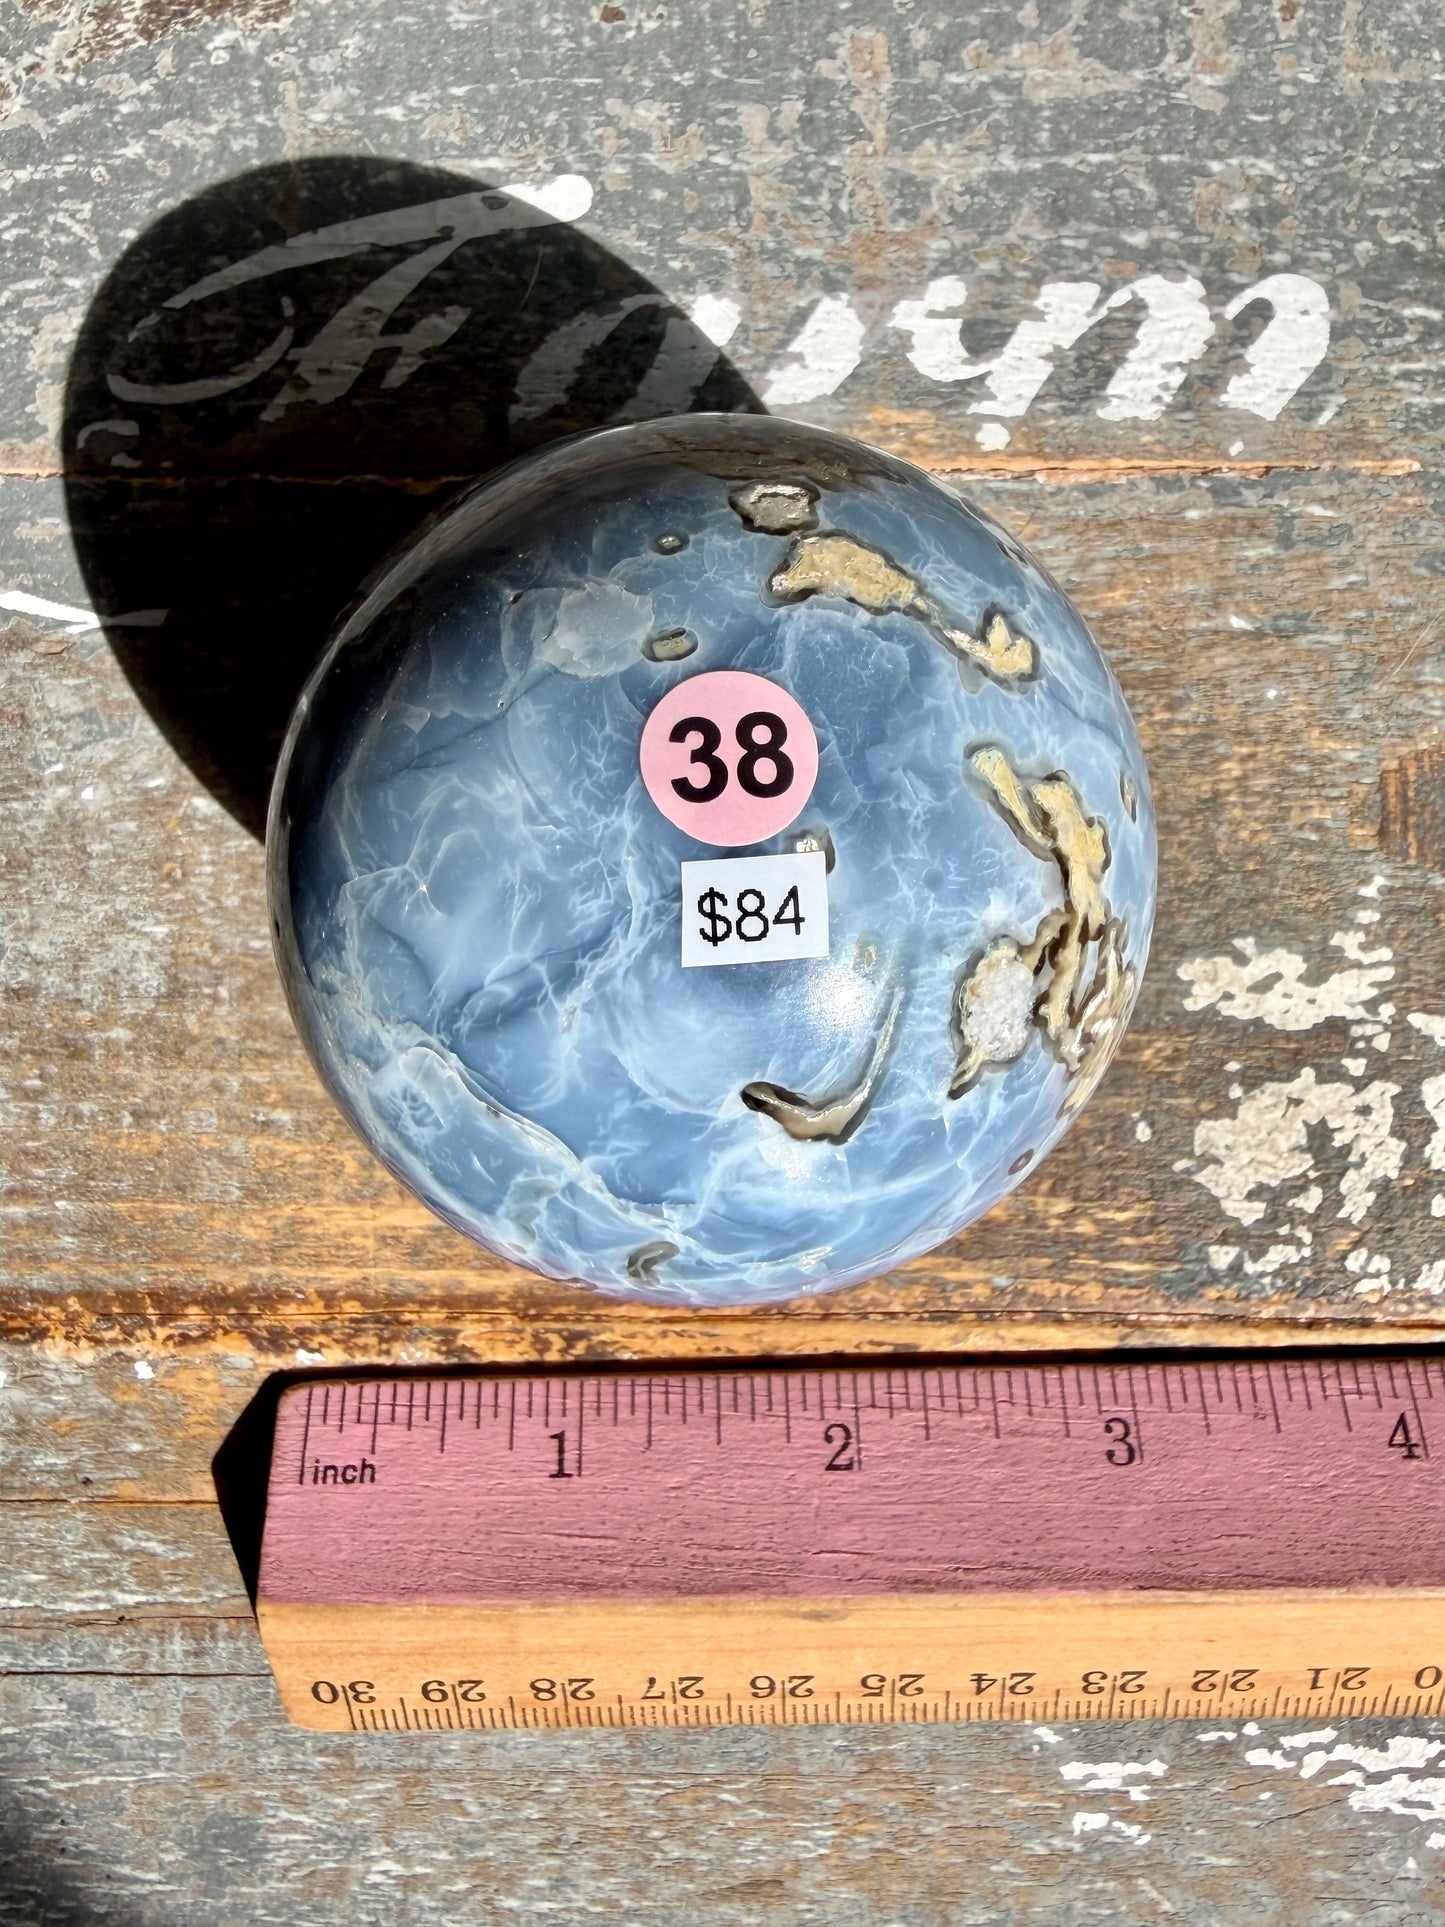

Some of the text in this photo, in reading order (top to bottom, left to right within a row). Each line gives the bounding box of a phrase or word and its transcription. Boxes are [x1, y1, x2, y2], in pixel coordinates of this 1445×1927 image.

[669, 711, 794, 803] 38
[697, 885, 805, 947] $84
[549, 1411, 1420, 1478] 1 2 3 4
[312, 1458, 377, 1484] inch
[420, 1679, 486, 1703] 29
[529, 1677, 596, 1702] 28
[640, 1676, 706, 1701] 27
[750, 1675, 815, 1700] 26
[861, 1673, 926, 1698] 25
[969, 1672, 1037, 1697] 24
[1081, 1670, 1148, 1695] 23
[1191, 1668, 1260, 1692] 22
[1306, 1667, 1371, 1691] 21
[310, 1680, 377, 1705] 30
